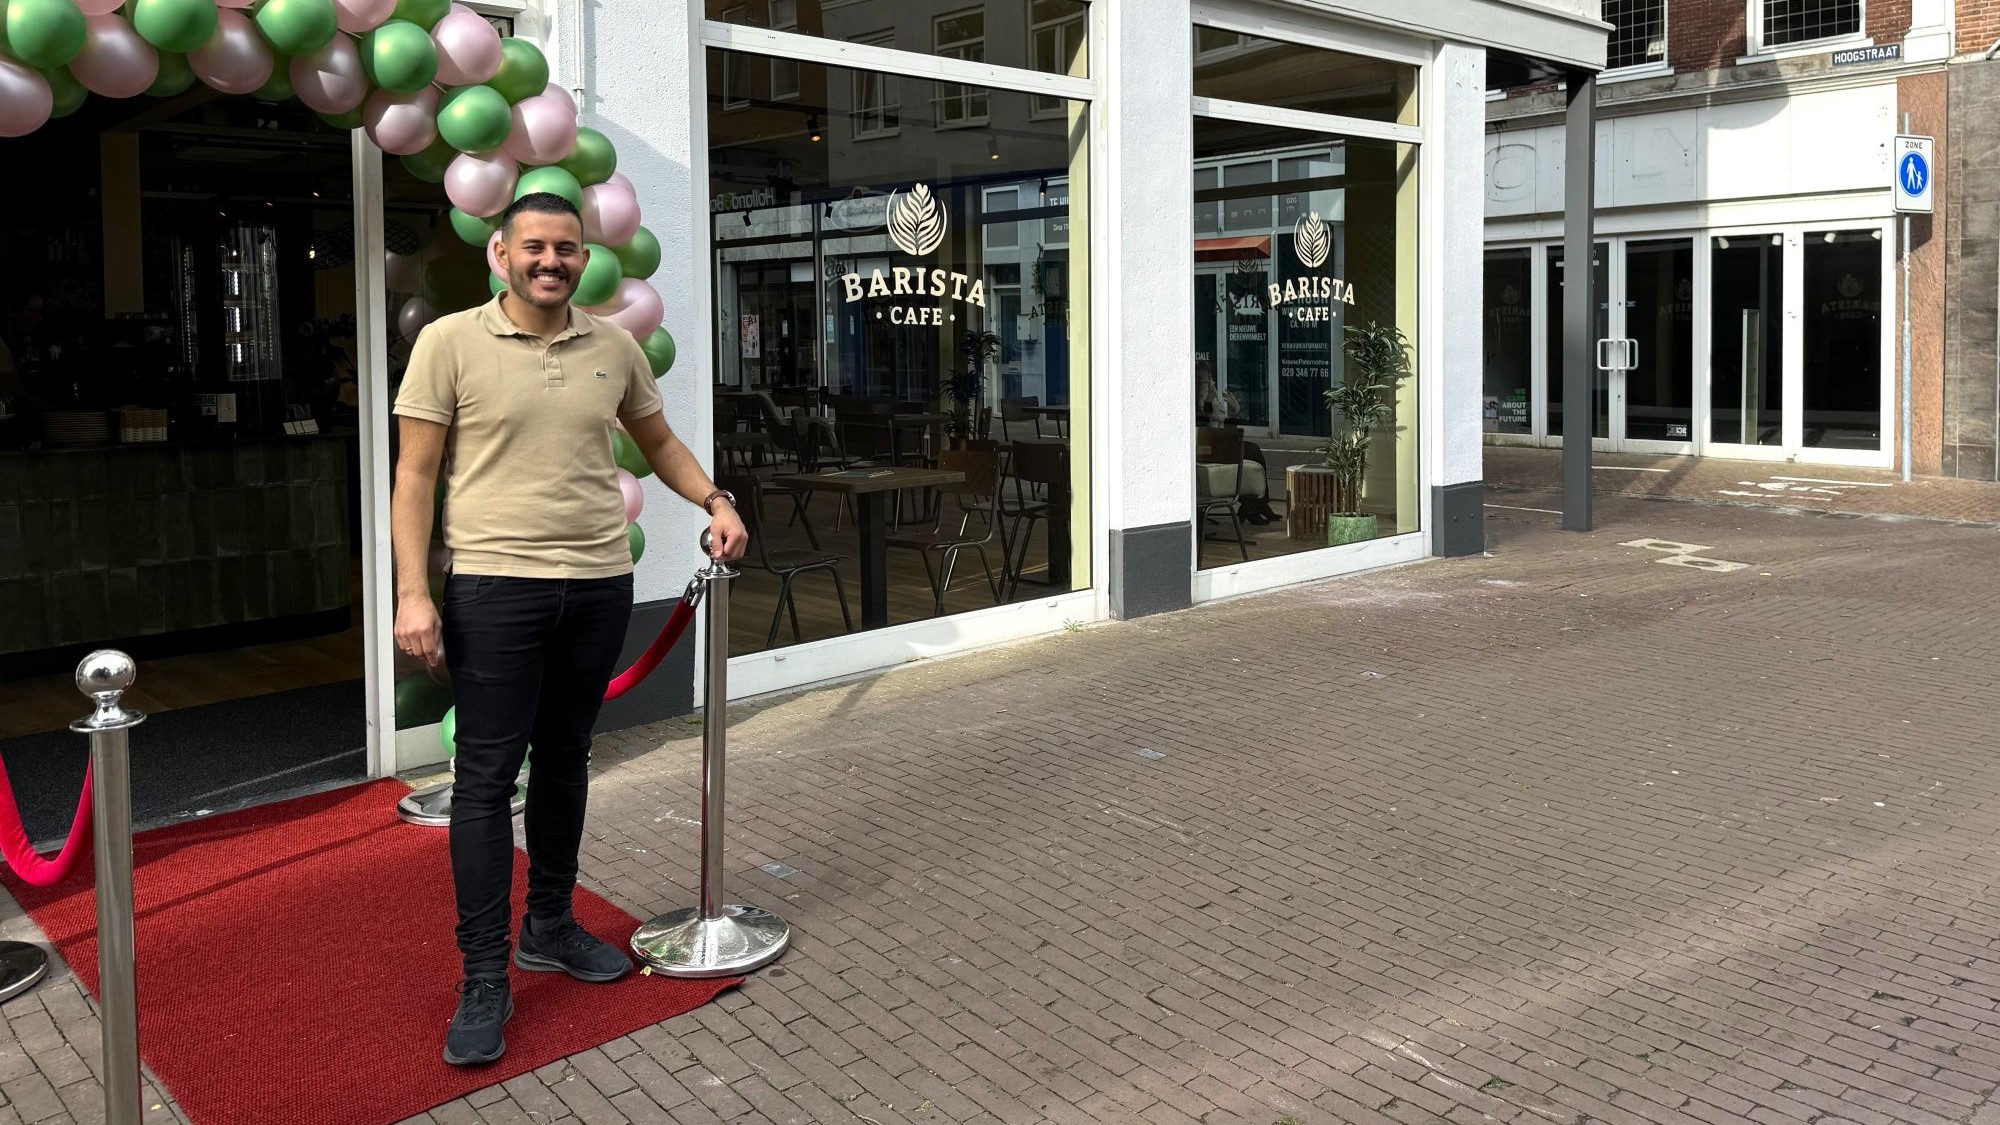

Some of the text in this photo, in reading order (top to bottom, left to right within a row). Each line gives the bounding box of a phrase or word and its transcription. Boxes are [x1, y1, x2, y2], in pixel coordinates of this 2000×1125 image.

[1834, 45, 1899, 64] HOOGSTRAAT
[1905, 141, 1923, 149] ZONE
[841, 267, 986, 308] BARISTA
[1268, 276, 1356, 306] BARISTA
[890, 306, 943, 325] CAFE
[1297, 306, 1329, 322] CAFE
[1281, 367, 1295, 377] 020
[1309, 367, 1319, 379] 77
[1498, 415, 1527, 423] FUTURE
